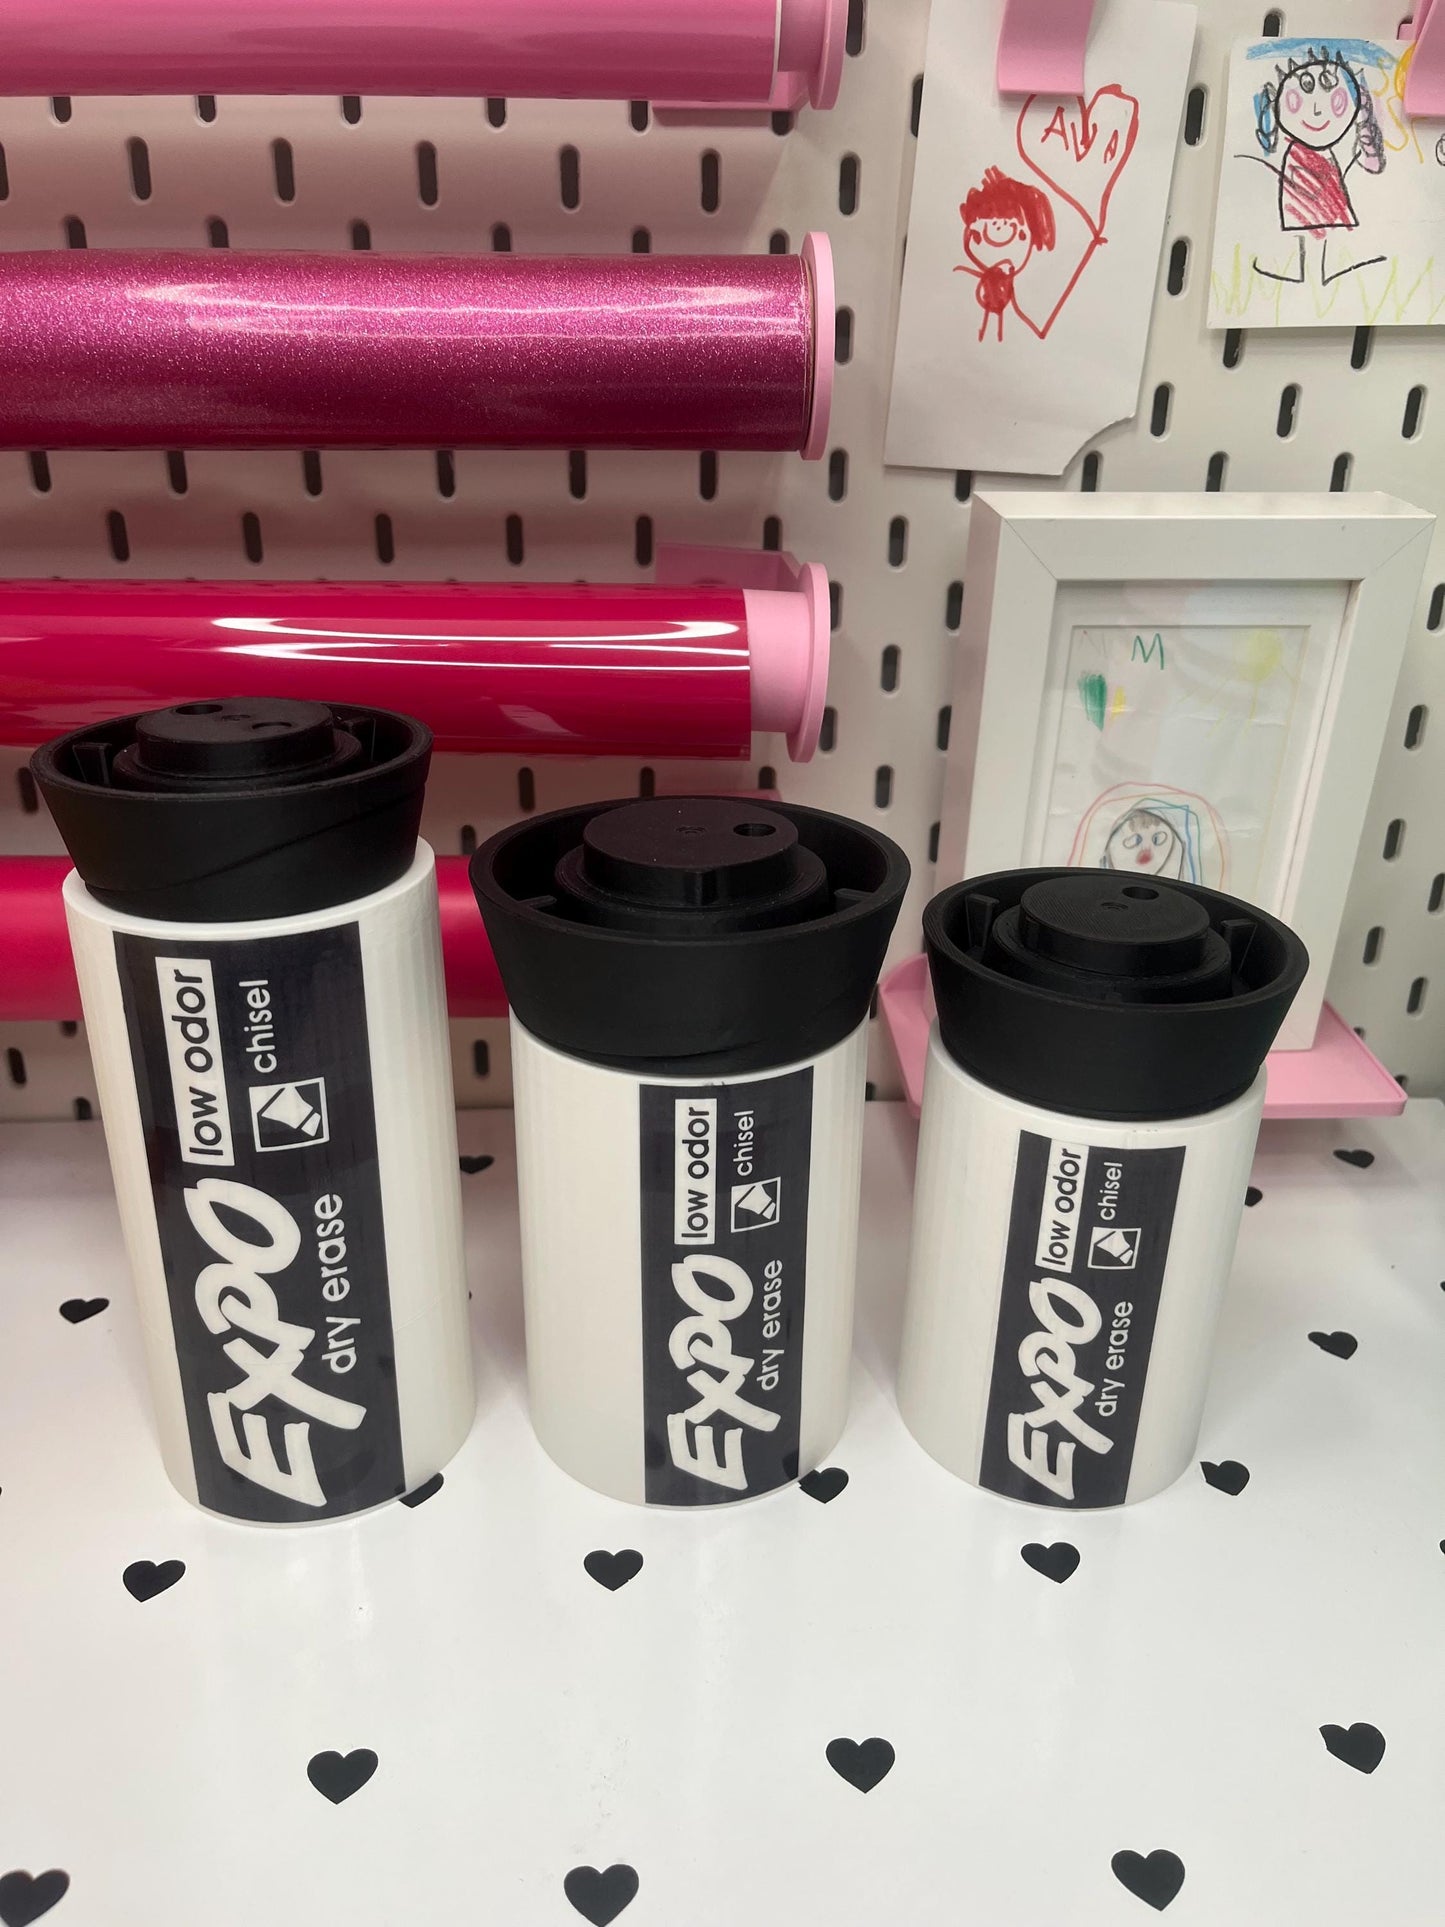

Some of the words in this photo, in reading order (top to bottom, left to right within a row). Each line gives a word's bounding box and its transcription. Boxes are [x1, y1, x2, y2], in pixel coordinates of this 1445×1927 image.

[1041, 106, 1118, 163] AVA
[1131, 633, 1164, 670] M
[171, 969, 213, 1073] odor
[239, 980, 278, 1073] chisel
[189, 1086, 224, 1155] low
[682, 1107, 710, 1179] odor
[733, 1110, 754, 1176] chisel
[681, 1189, 708, 1237] low
[1053, 1148, 1081, 1213] odor
[1098, 1162, 1123, 1221] chisel
[314, 1193, 350, 1301] erase
[1042, 1220, 1071, 1265] low
[762, 1260, 783, 1338] erase
[183, 1178, 367, 1506] EXPO
[321, 1316, 361, 1374] dry
[1105, 1301, 1133, 1370] erase
[667, 1254, 781, 1490] EXPO
[756, 1349, 784, 1391] dry
[1008, 1277, 1114, 1500] EXPO
[1094, 1378, 1125, 1417] dry
